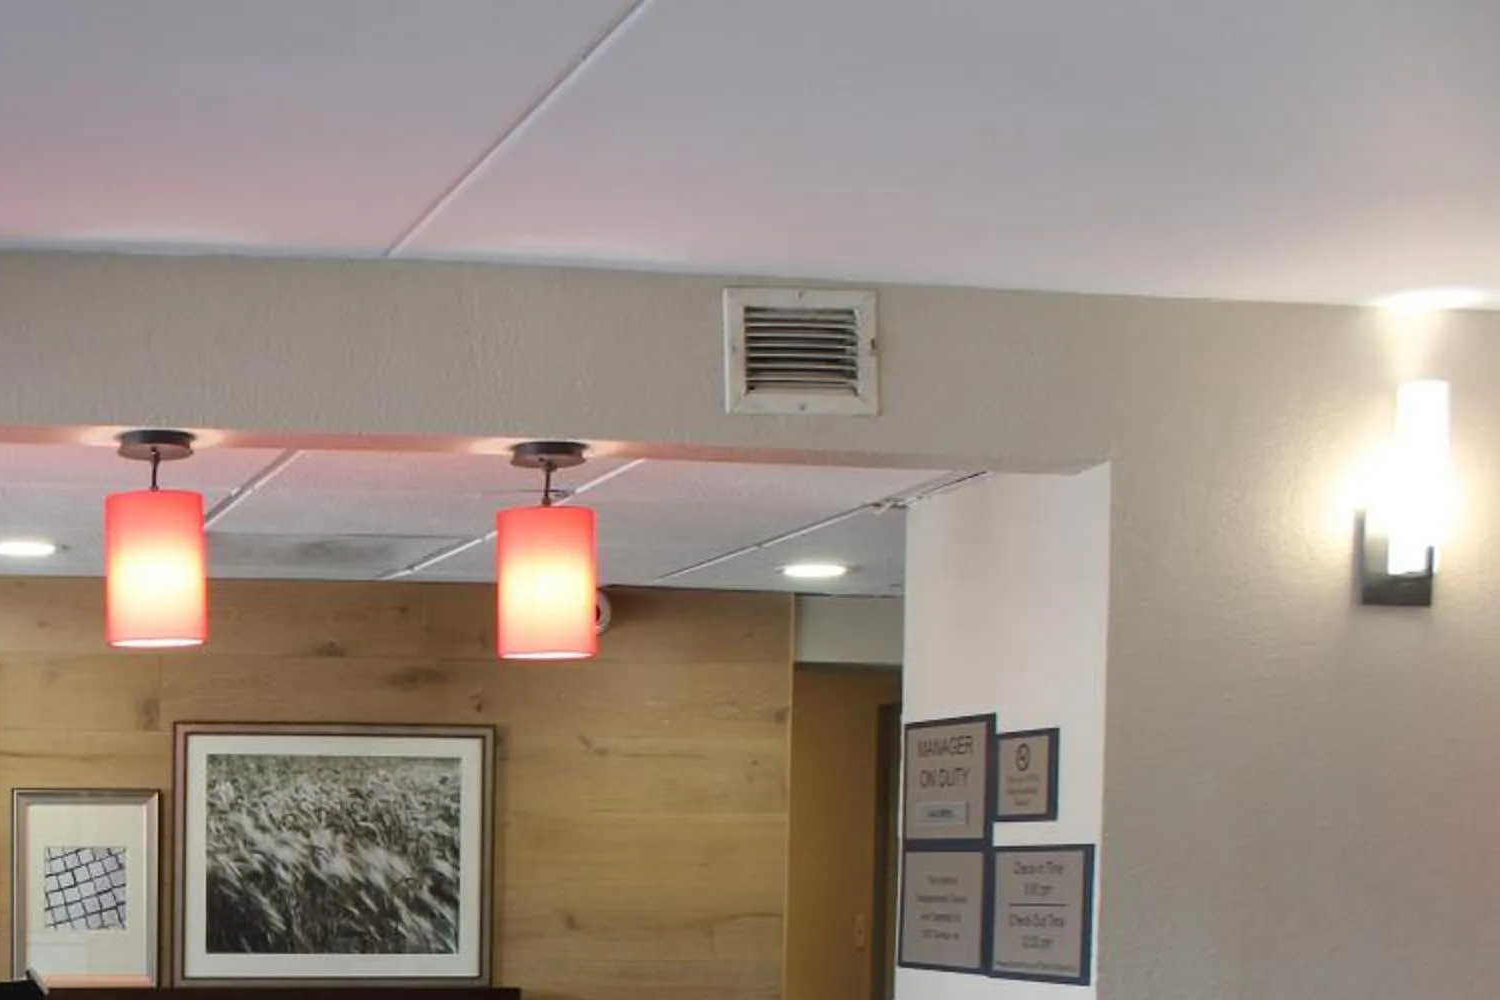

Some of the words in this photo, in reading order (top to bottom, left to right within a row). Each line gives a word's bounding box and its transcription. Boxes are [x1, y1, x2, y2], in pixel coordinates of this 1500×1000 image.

[917, 735, 974, 757] MANAGER
[919, 768, 938, 789] ON
[939, 766, 971, 788] DUTY
